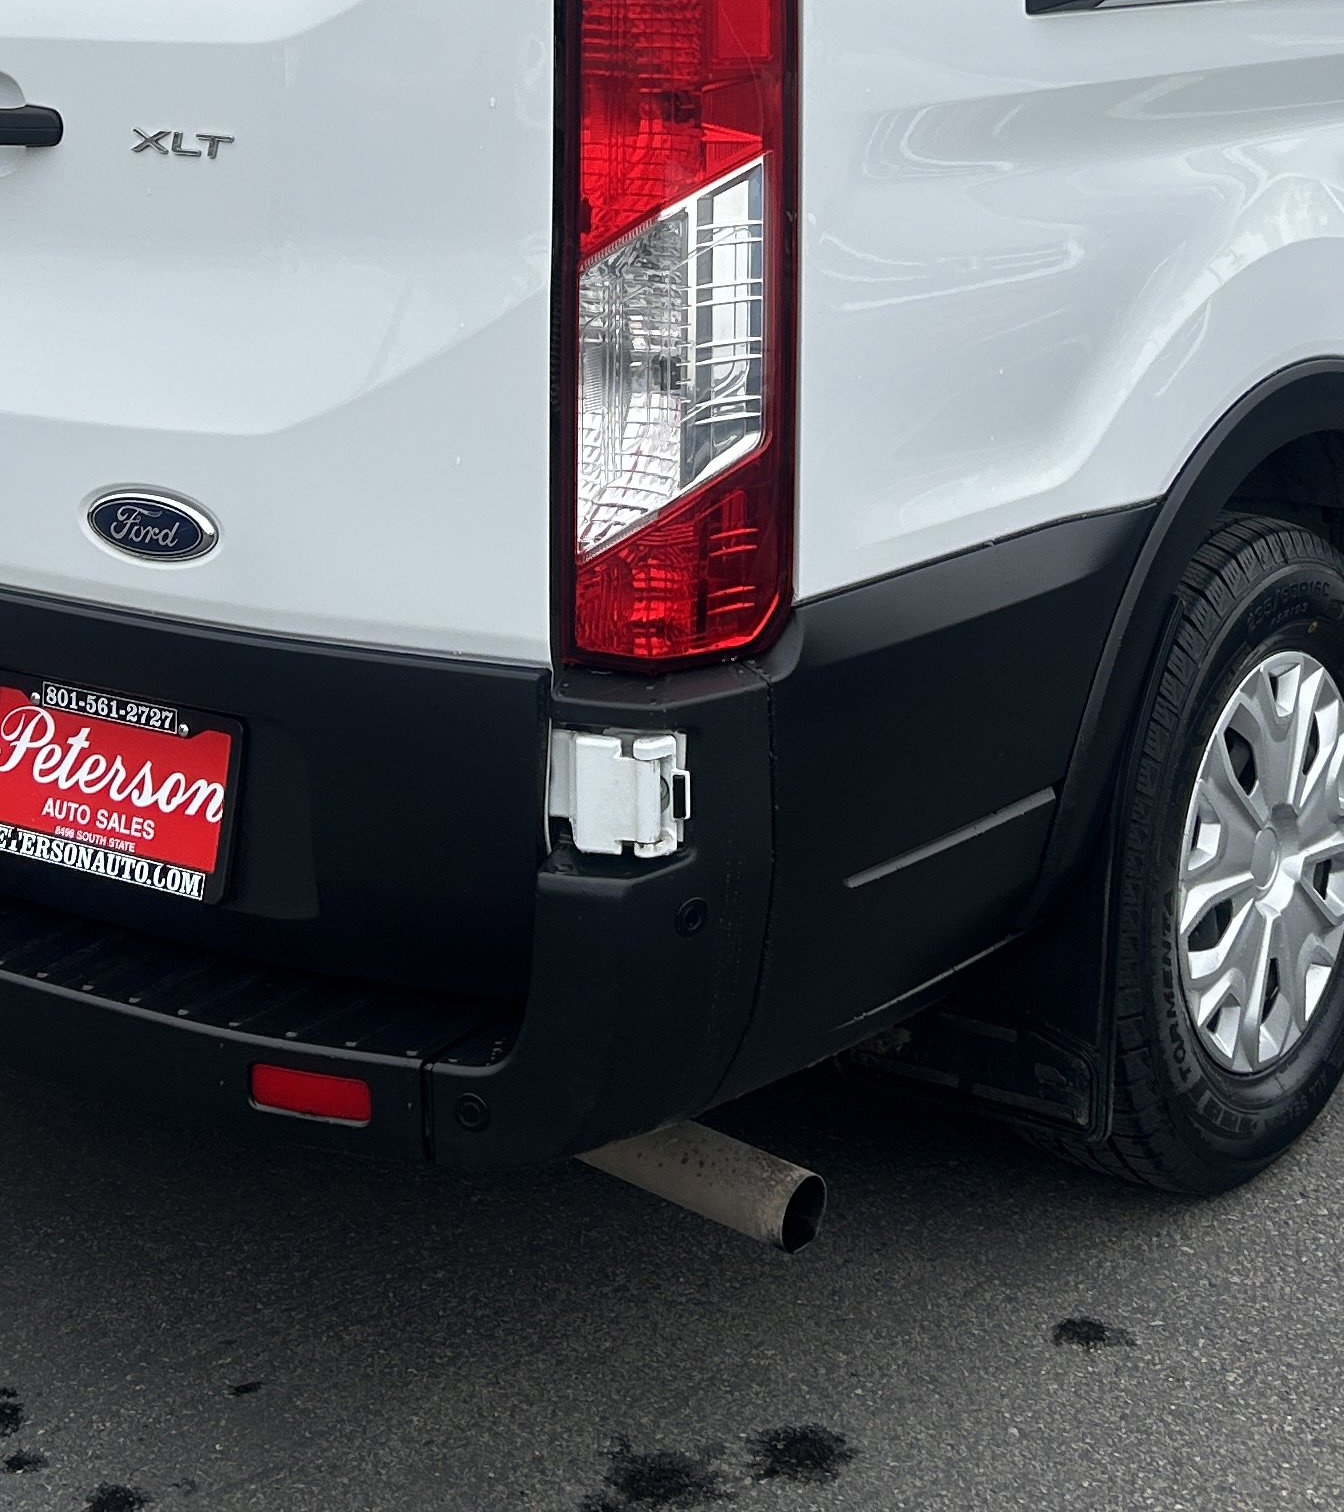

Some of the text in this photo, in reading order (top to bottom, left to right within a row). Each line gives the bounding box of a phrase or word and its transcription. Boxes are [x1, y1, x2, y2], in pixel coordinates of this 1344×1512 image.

[131, 127, 235, 159] XLT
[110, 505, 181, 547] Ford
[45, 686, 174, 729] 801-561-2727
[42, 798, 155, 840] AUTO SALES
[76, 830, 107, 847] SOUTH
[108, 837, 136, 853] STATE
